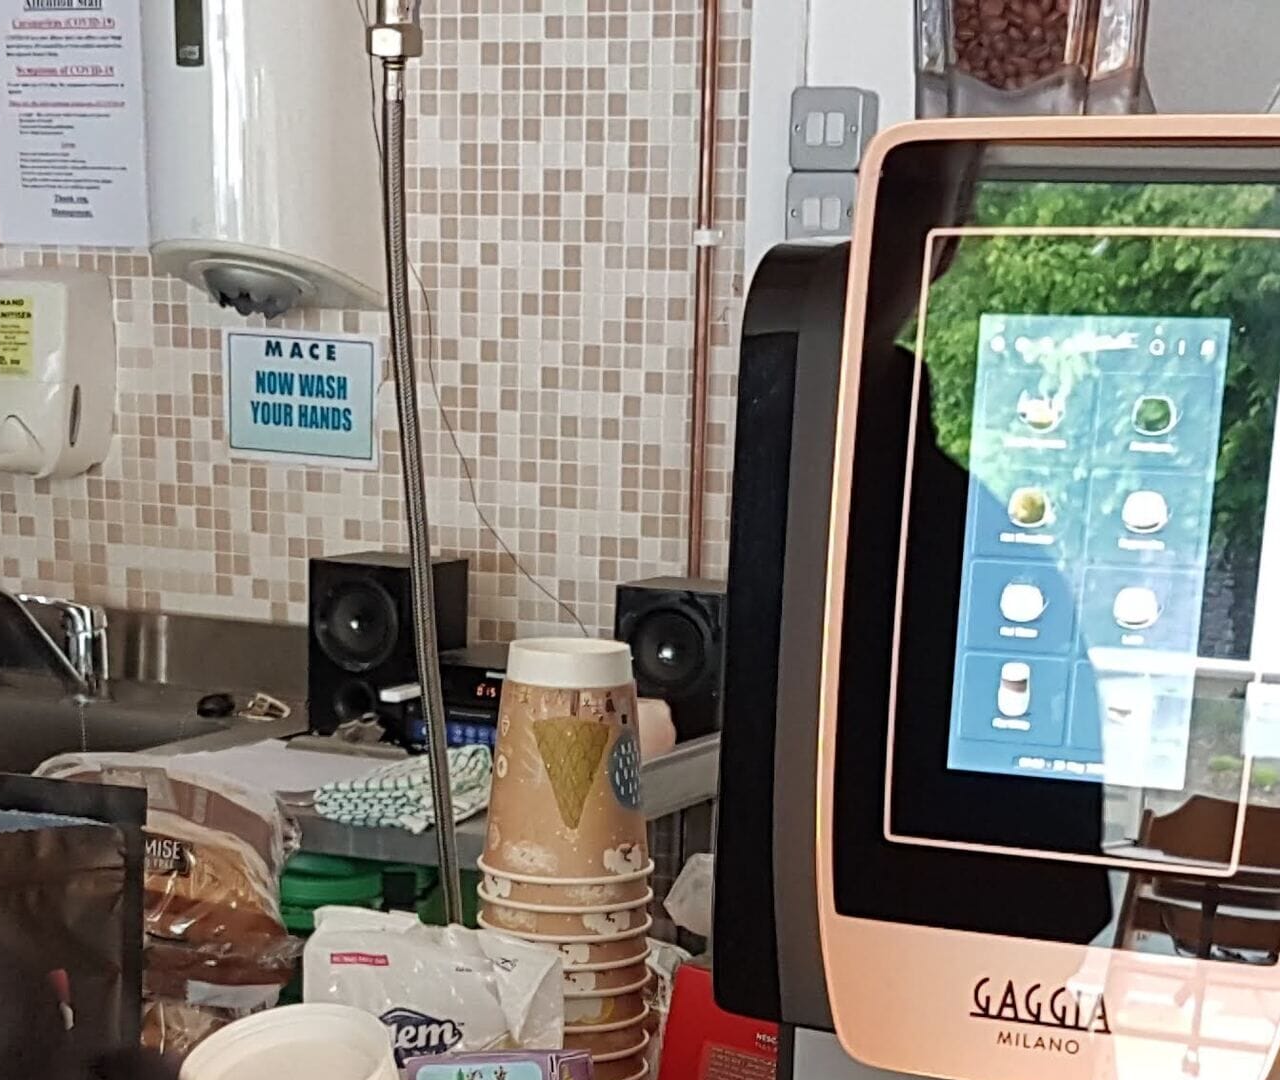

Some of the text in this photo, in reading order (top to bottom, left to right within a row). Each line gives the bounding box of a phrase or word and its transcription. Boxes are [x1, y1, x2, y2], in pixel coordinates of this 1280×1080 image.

[0, 298, 24, 306] HAND
[264, 339, 337, 361] MACE
[255, 370, 348, 400] NOW WASH
[250, 401, 352, 432] YOUR HANDS
[969, 977, 1112, 1034] GAGGIA
[997, 1031, 1080, 1055] MILANO
